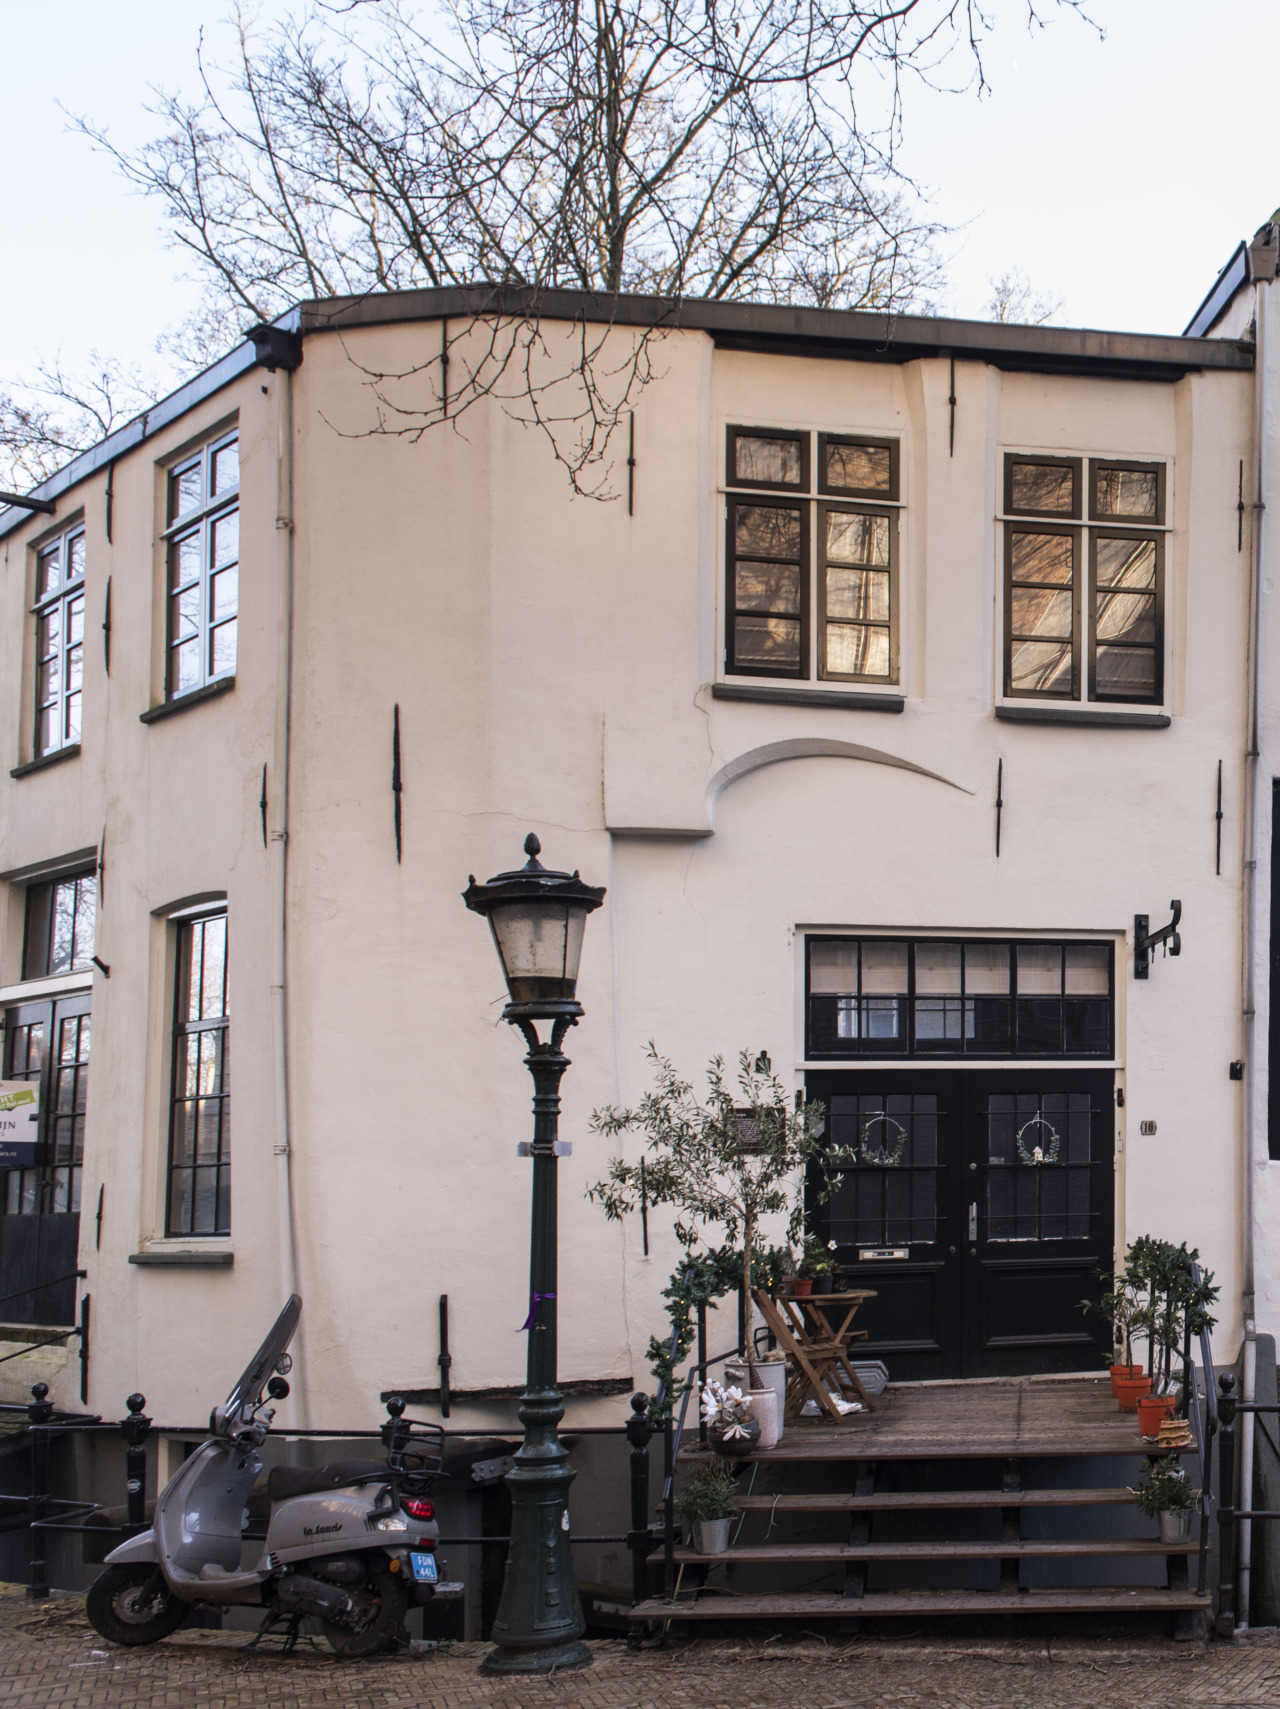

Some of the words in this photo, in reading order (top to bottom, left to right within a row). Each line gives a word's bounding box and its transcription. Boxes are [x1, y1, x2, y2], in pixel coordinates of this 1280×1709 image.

[1144, 1122, 1154, 1134] 10
[418, 1556, 432, 1566] FDN
[420, 1567, 434, 1577] 44L
